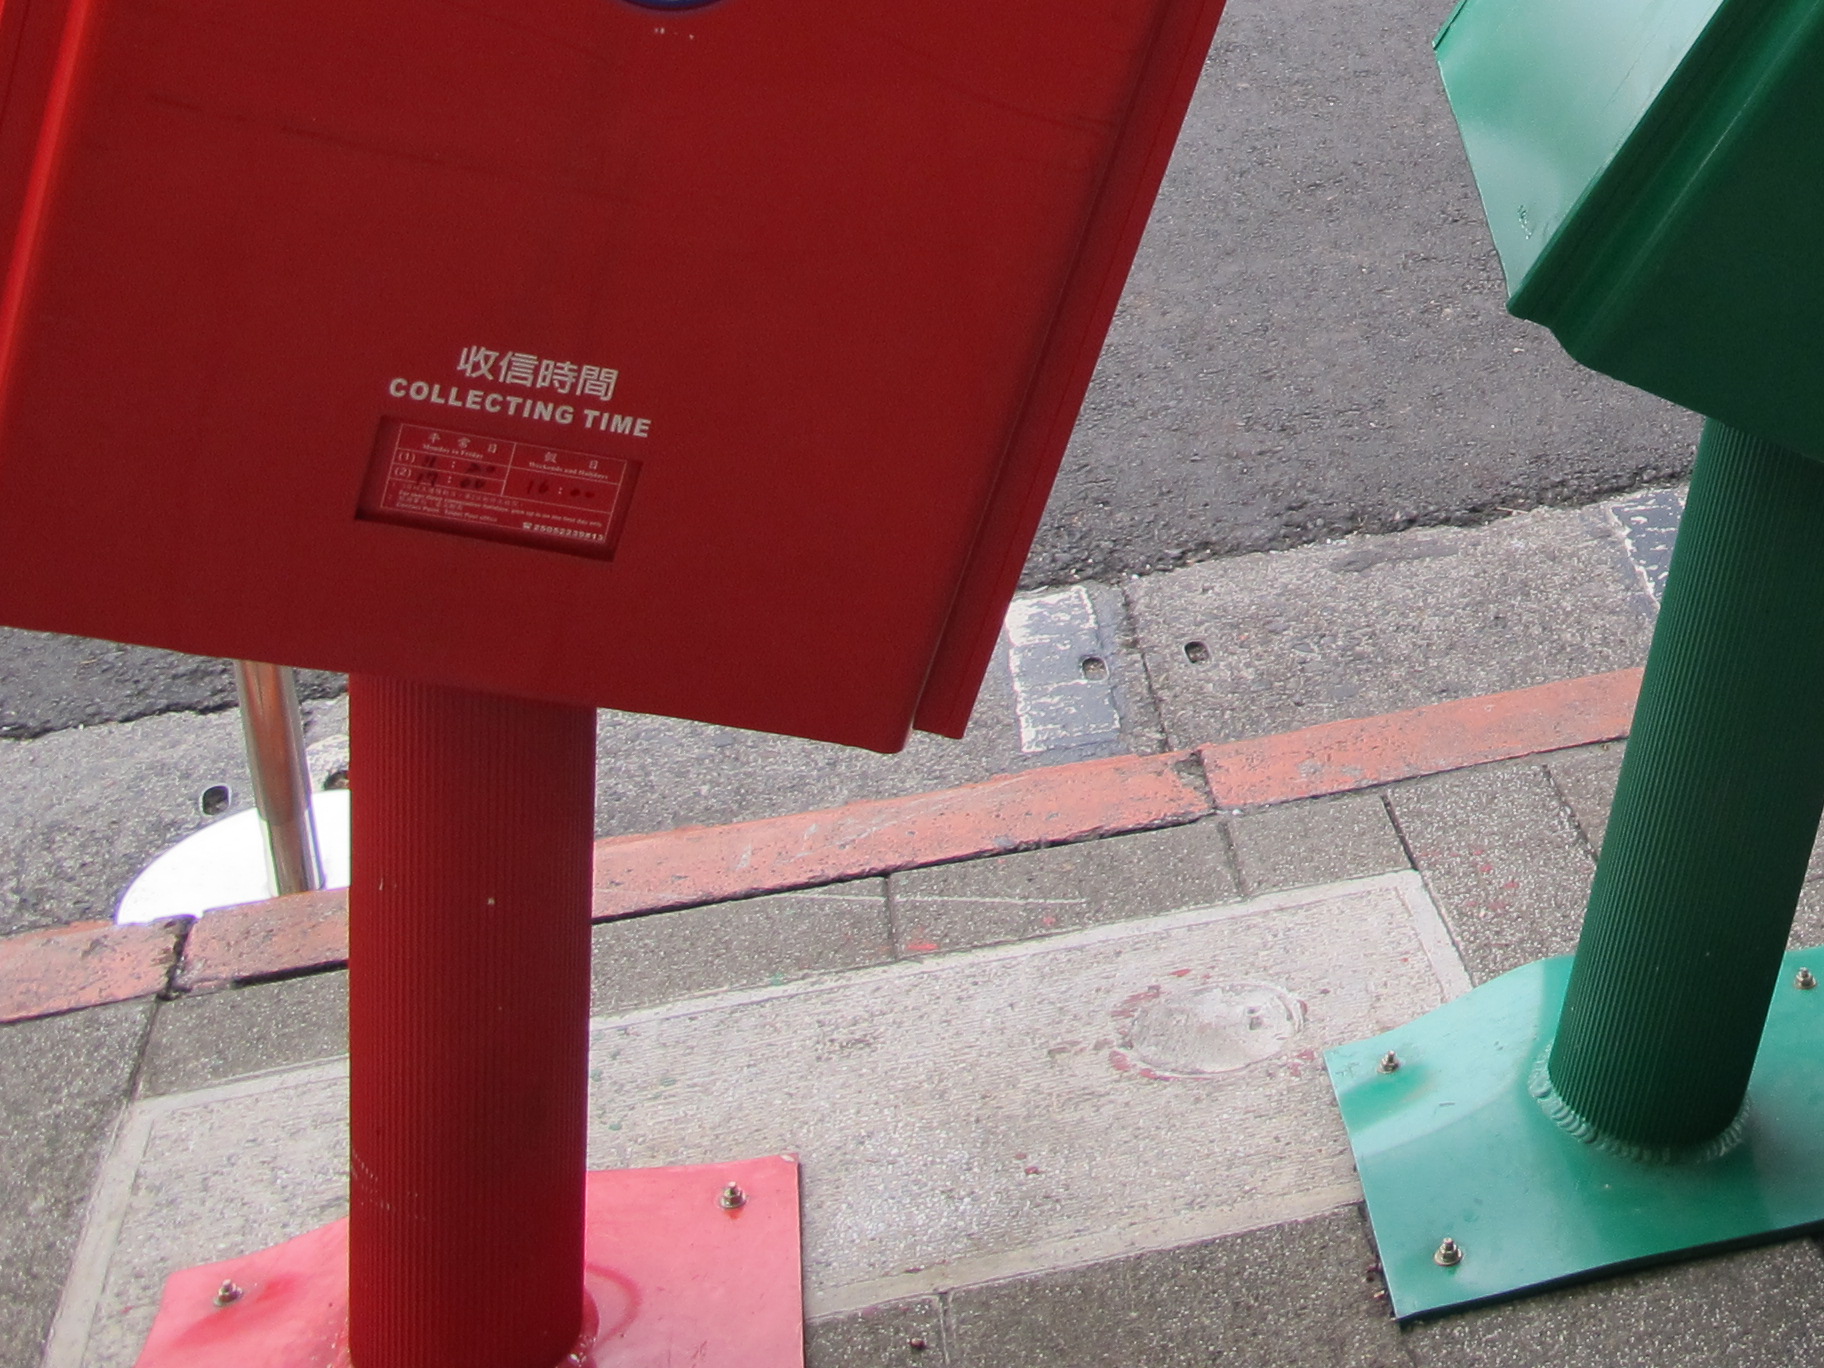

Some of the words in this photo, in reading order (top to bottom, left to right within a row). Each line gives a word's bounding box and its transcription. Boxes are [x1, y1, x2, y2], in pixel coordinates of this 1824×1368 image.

[456, 345, 619, 402] 收信時間
[389, 377, 574, 425] COLLECTING
[583, 408, 652, 438] TIME
